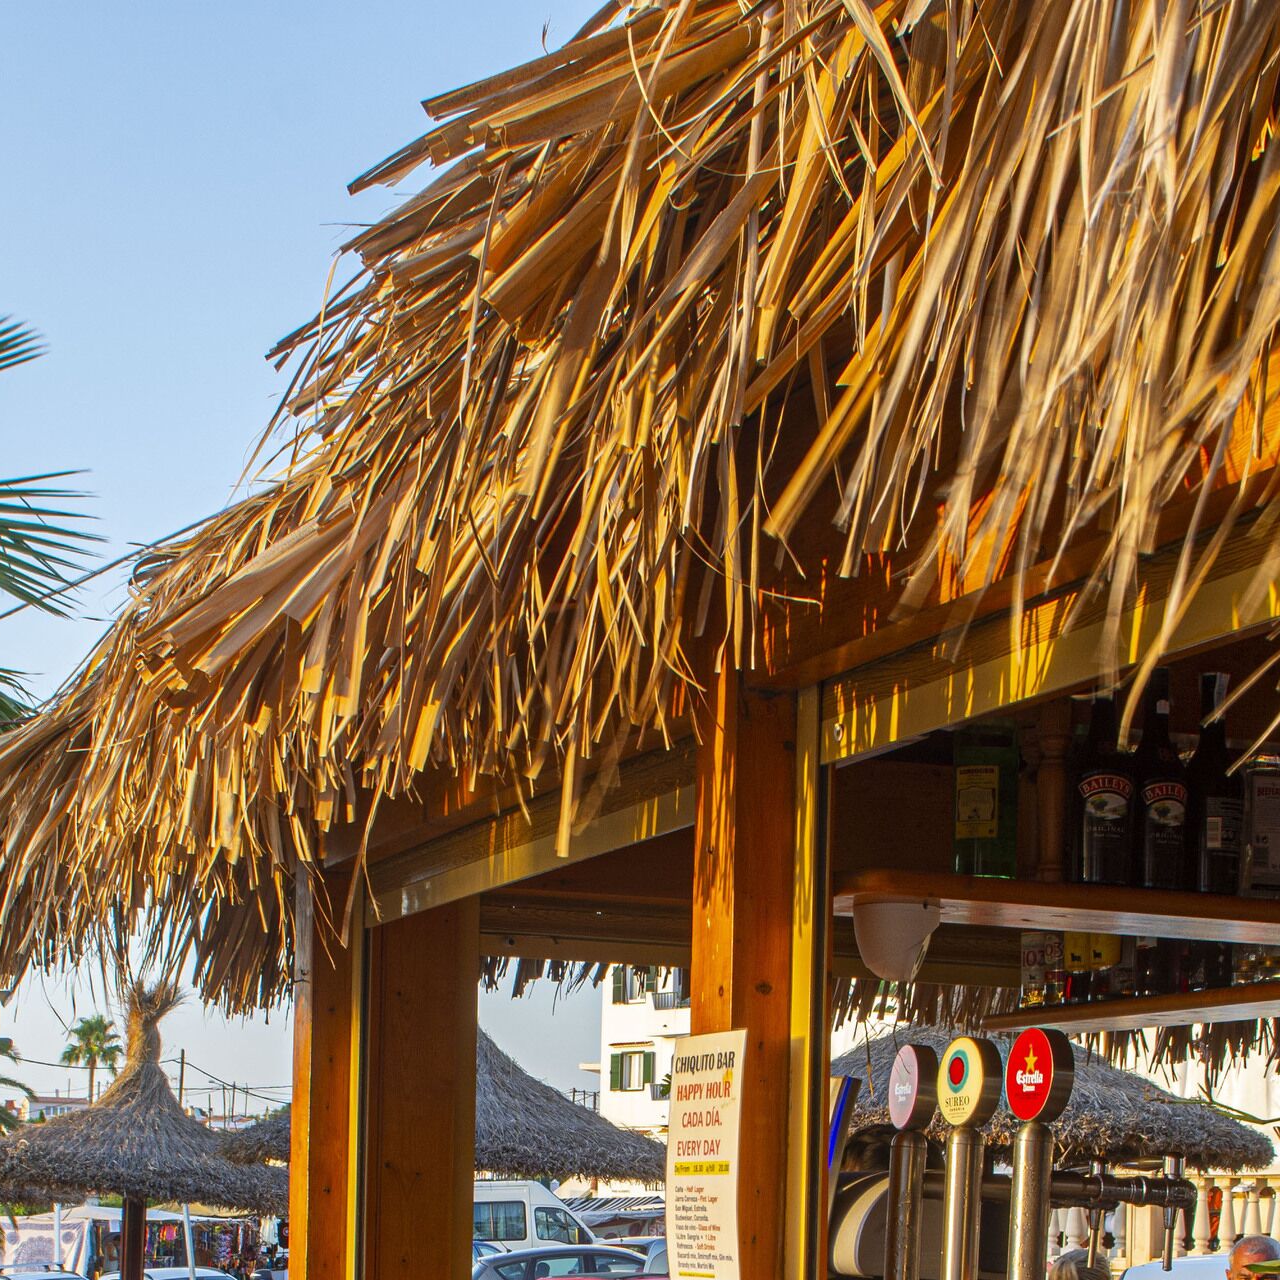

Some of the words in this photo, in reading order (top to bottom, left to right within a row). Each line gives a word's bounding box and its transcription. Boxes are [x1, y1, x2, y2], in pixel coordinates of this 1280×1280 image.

[1081, 777, 1130, 793] BAILEYS
[675, 1053, 715, 1075] CHIQUITO
[717, 1051, 735, 1069] BAR
[1016, 1069, 1043, 1085] Estrella
[677, 1083, 704, 1101] HAPPY
[706, 1081, 731, 1099] HOUR
[945, 1095, 970, 1107] SUREO
[682, 1111, 703, 1128] CADA
[705, 1106, 722, 1126] DÍA.
[677, 1140, 702, 1156] EVERY
[704, 1139, 721, 1156] DAY
